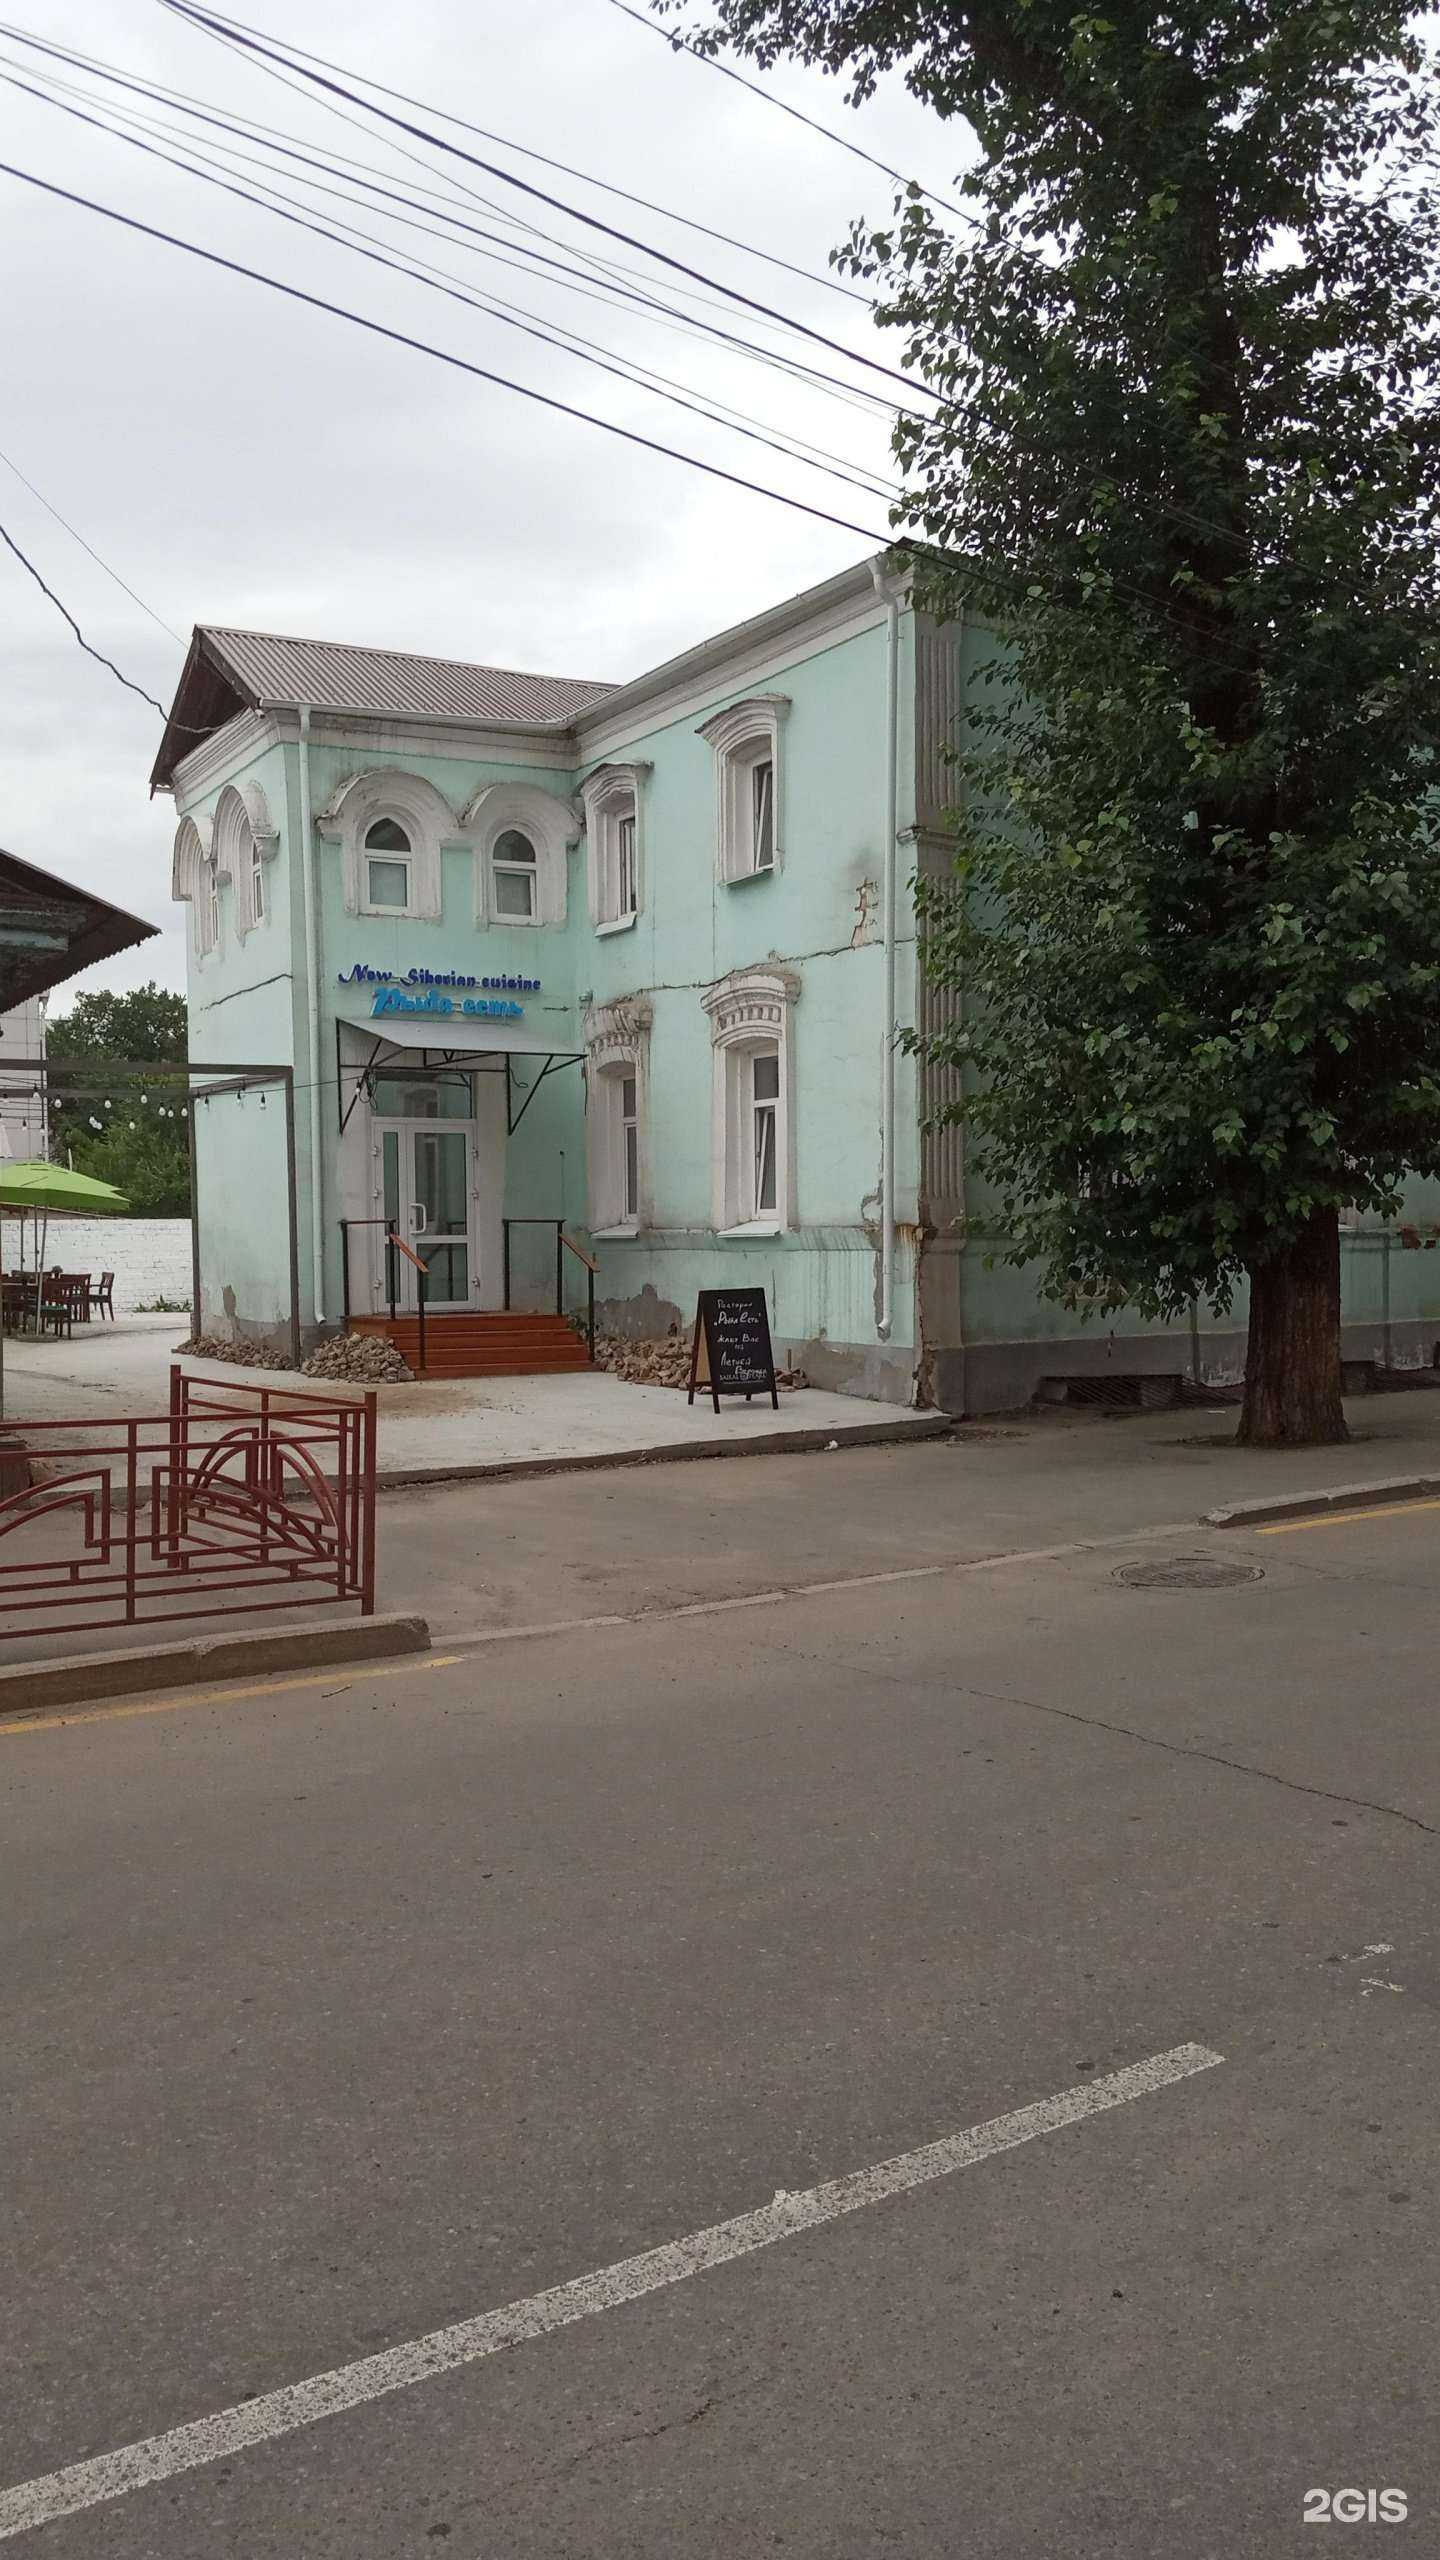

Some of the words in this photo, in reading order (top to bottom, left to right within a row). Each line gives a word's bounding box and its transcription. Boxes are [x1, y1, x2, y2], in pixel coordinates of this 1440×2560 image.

[338, 963, 392, 983] New
[400, 968, 476, 987] Siberian
[482, 974, 541, 991] cuisine
